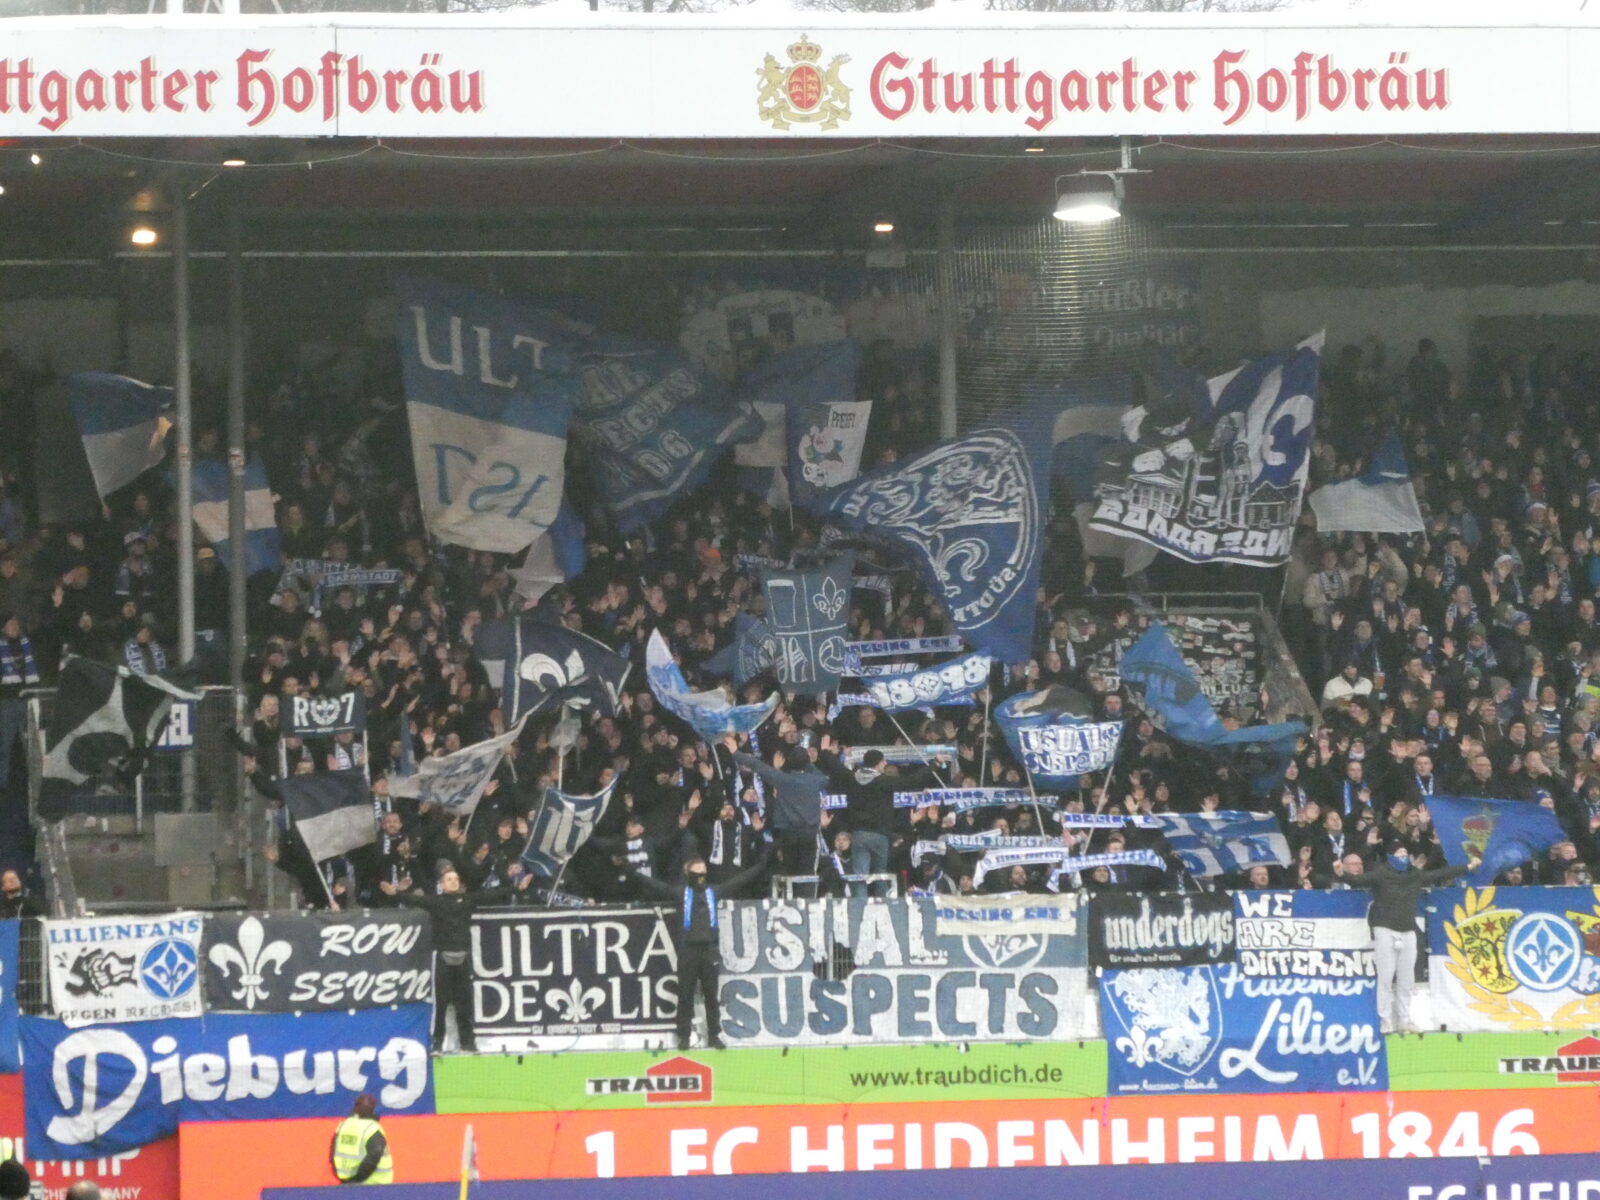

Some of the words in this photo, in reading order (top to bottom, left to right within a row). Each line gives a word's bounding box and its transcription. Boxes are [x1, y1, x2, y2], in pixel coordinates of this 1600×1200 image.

[236, 48, 488, 127] Hofbräu
[869, 51, 1199, 132] Stuttgarter
[1213, 49, 1453, 127] Hofbräu
[1104, 898, 1234, 957] underdogs
[1240, 892, 1294, 918] WE
[49, 917, 201, 945] LILIENFANS
[320, 922, 422, 957] ROW
[469, 920, 679, 978] ULTRA
[1237, 919, 1317, 949] ARE
[289, 969, 432, 1004] SEVEN
[472, 979, 543, 1024] DE
[719, 970, 1060, 1039] SUSPECTS
[1219, 996, 1382, 1084] Lilien
[46, 1027, 428, 1145] Dieburg
[588, 1077, 702, 1093] TRAUB
[850, 1063, 1063, 1088] www.traubdich.de
[790, 1113, 1325, 1173] HEIDENHEIM
[1350, 1108, 1540, 1159] 1846
